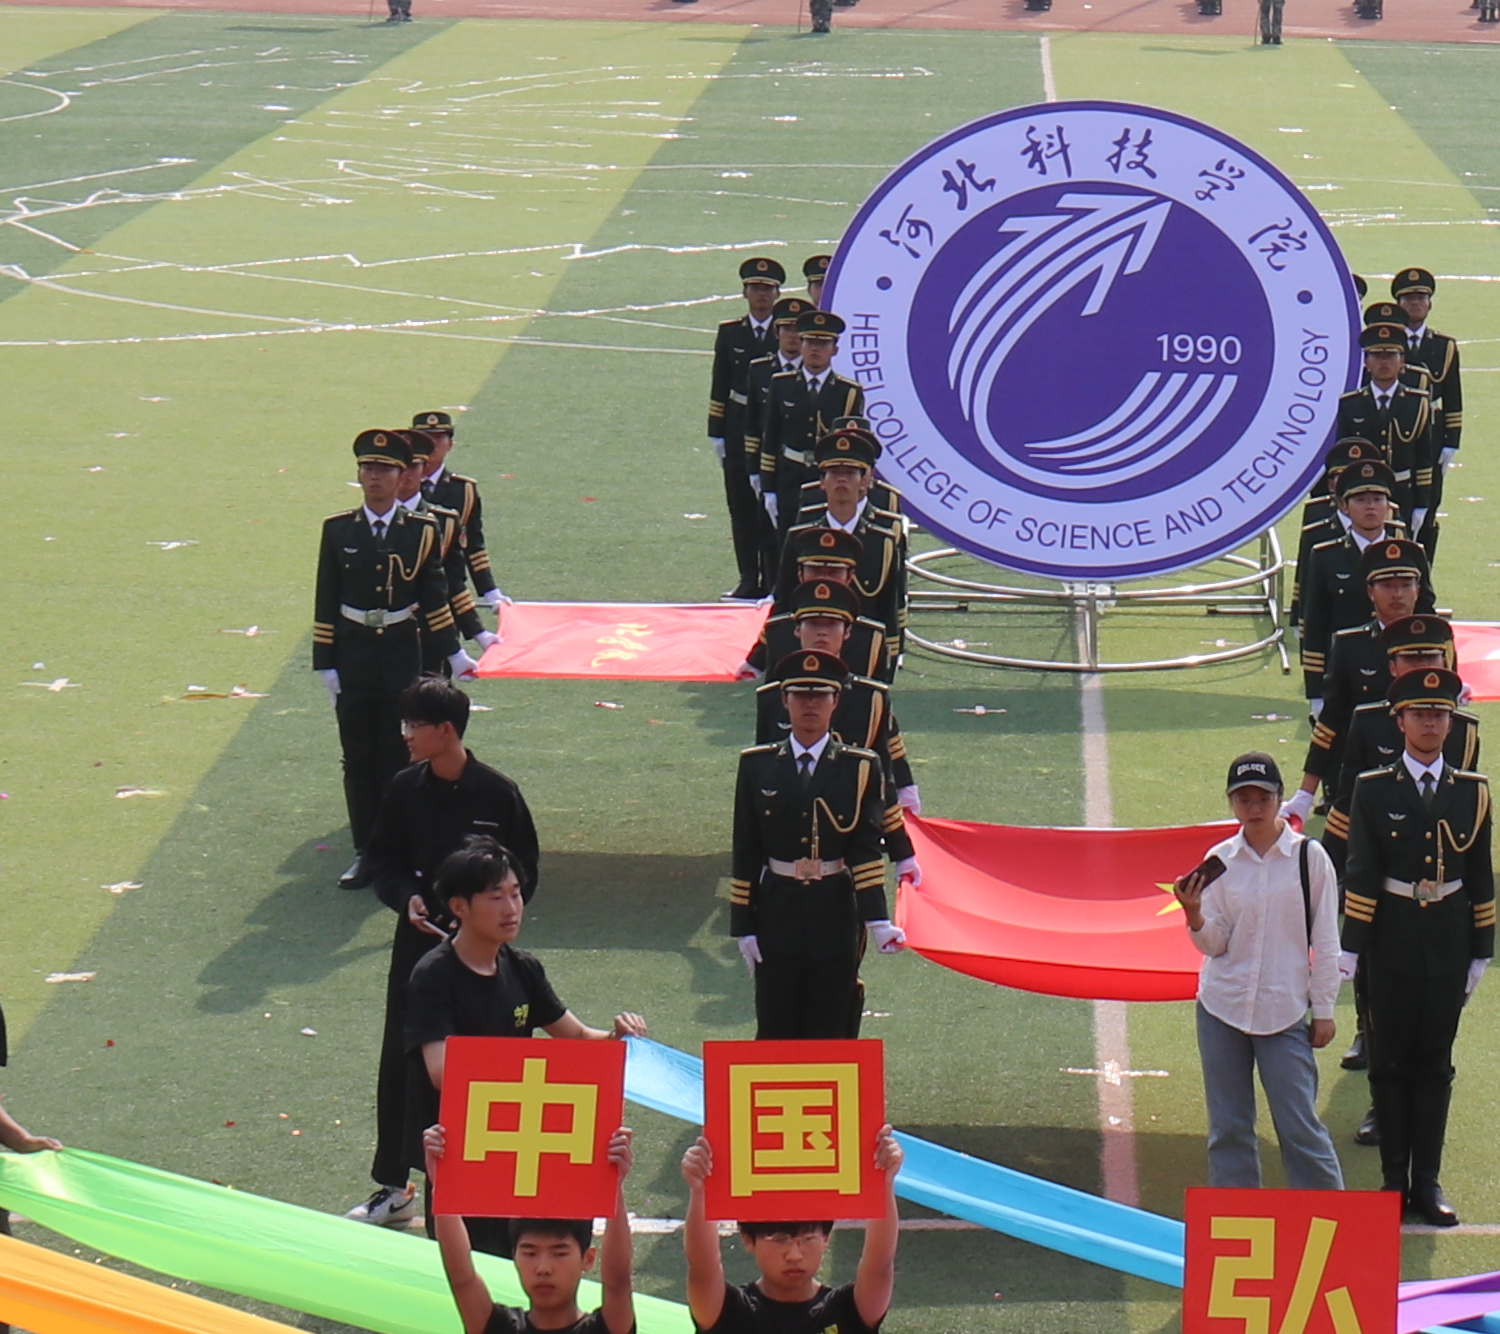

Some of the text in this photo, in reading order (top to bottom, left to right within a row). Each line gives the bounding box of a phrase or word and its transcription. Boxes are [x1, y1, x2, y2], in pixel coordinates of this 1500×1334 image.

[878, 124, 1308, 271] 河北科技学院
[1155, 333, 1243, 365] 1990
[850, 311, 1330, 551] HEBEI COLLEGE OF SCIENCE AND TECHNOLOGY
[462, 1057, 599, 1197] 中
[728, 1062, 861, 1197] 国
